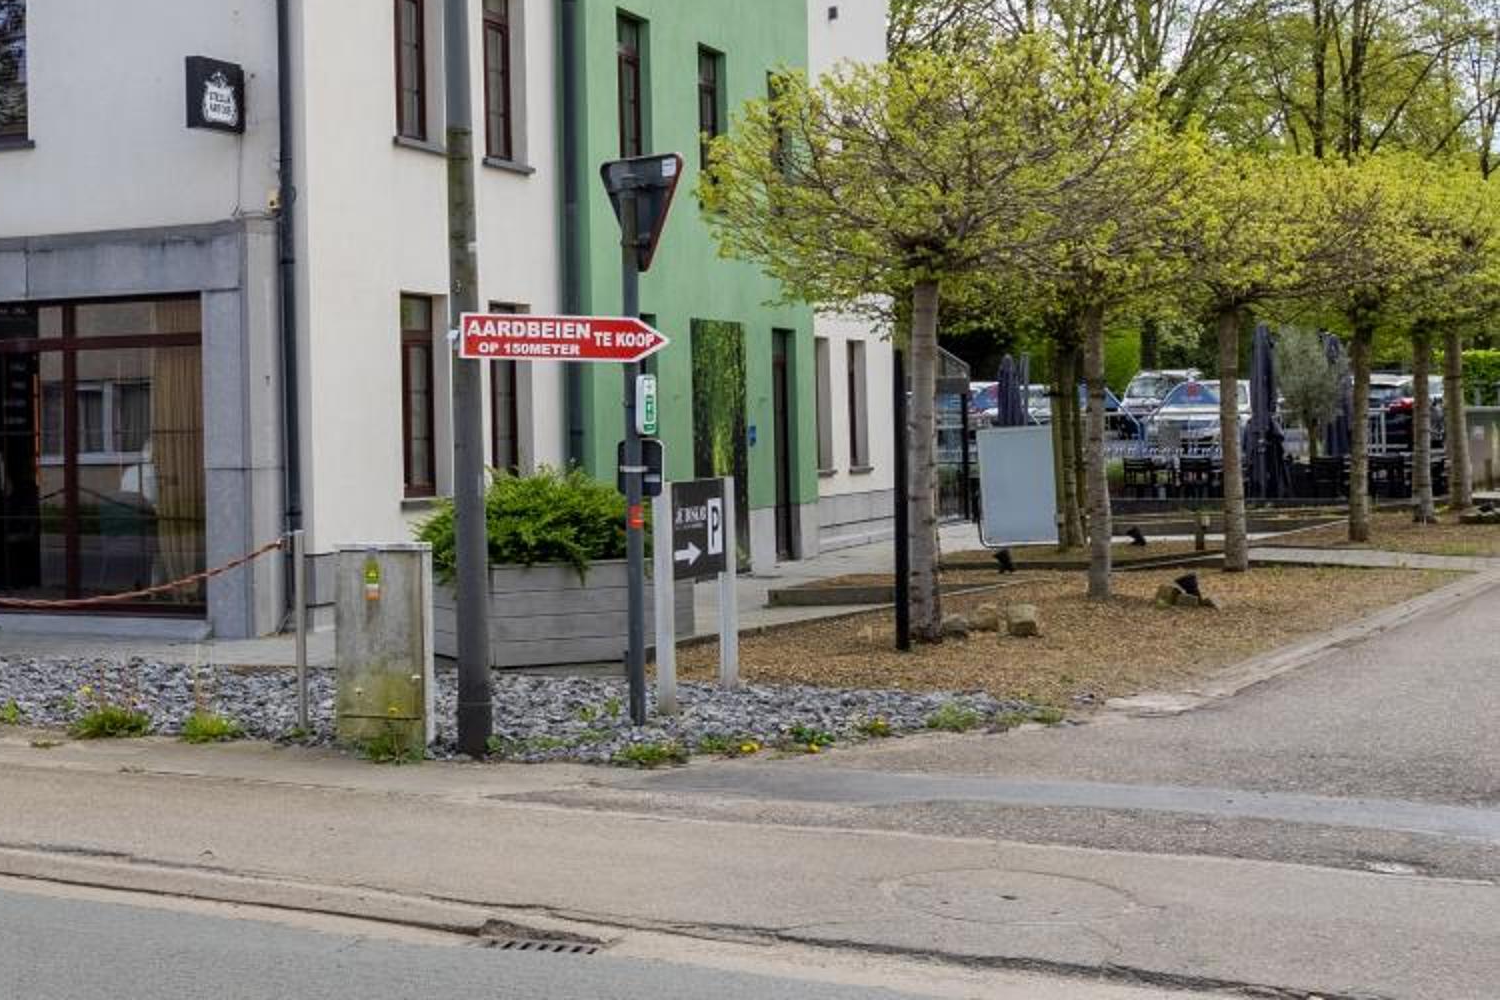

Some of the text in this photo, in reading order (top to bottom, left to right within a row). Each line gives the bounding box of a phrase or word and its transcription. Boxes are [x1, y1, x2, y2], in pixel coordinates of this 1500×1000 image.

[467, 319, 655, 348] AARDBEIEN TE KOOP
[478, 342, 580, 355] OP 150METER
[711, 505, 719, 549] P
